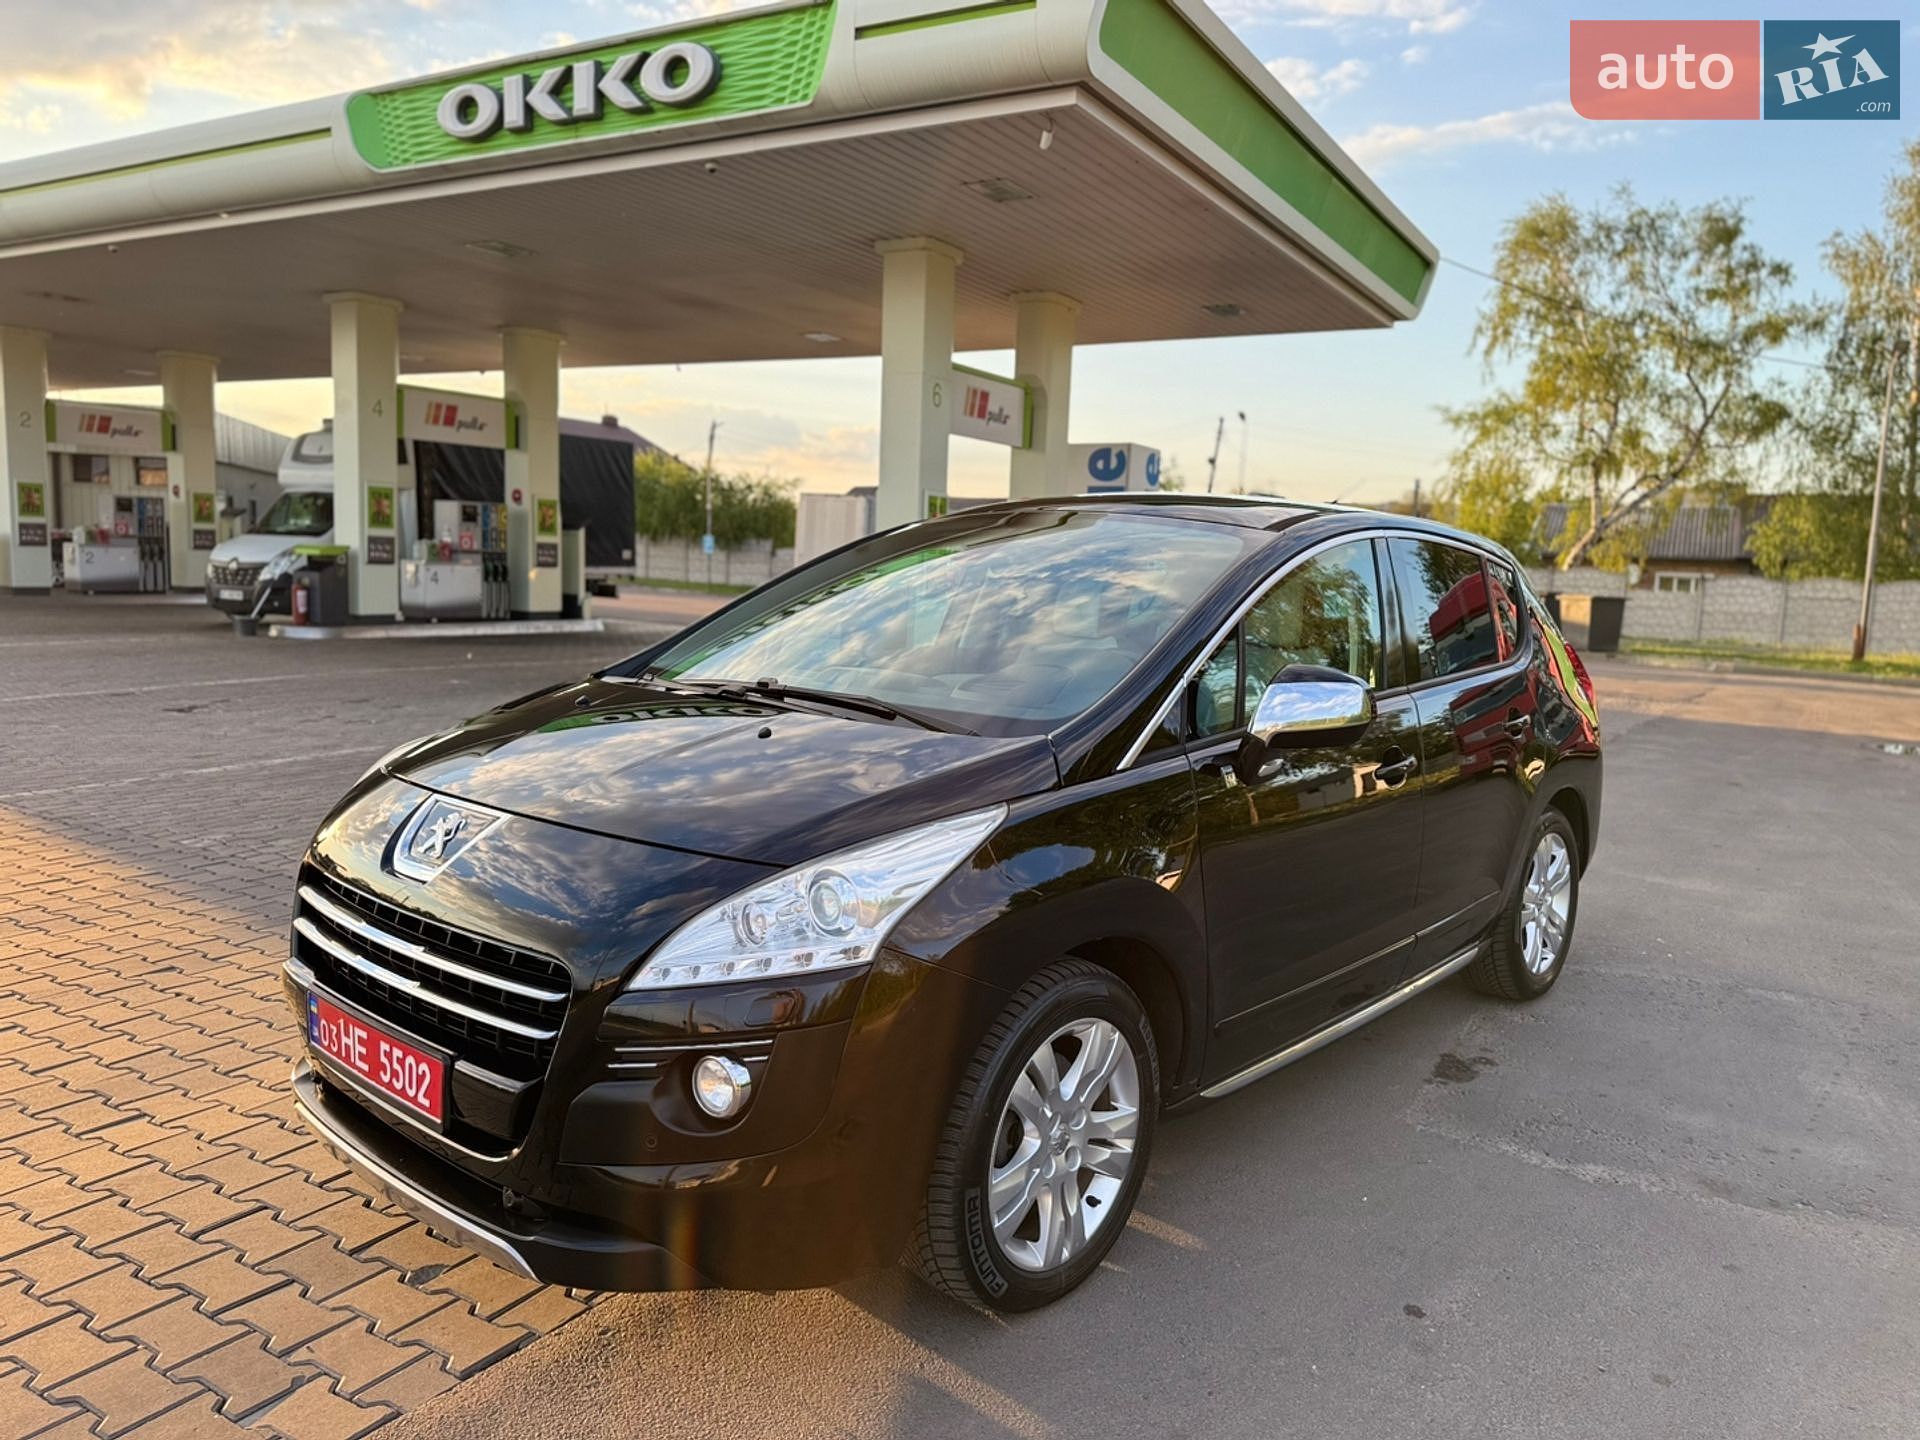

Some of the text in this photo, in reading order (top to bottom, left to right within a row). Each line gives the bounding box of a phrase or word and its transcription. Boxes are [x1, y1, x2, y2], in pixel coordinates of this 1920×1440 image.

[437, 41, 722, 142] OKKO
[932, 383, 942, 408] 6
[372, 399, 383, 417] 4
[20, 411, 32, 429] 2
[85, 551, 96, 564] 2
[430, 571, 439, 584] 4
[379, 1039, 432, 1108] 5502
